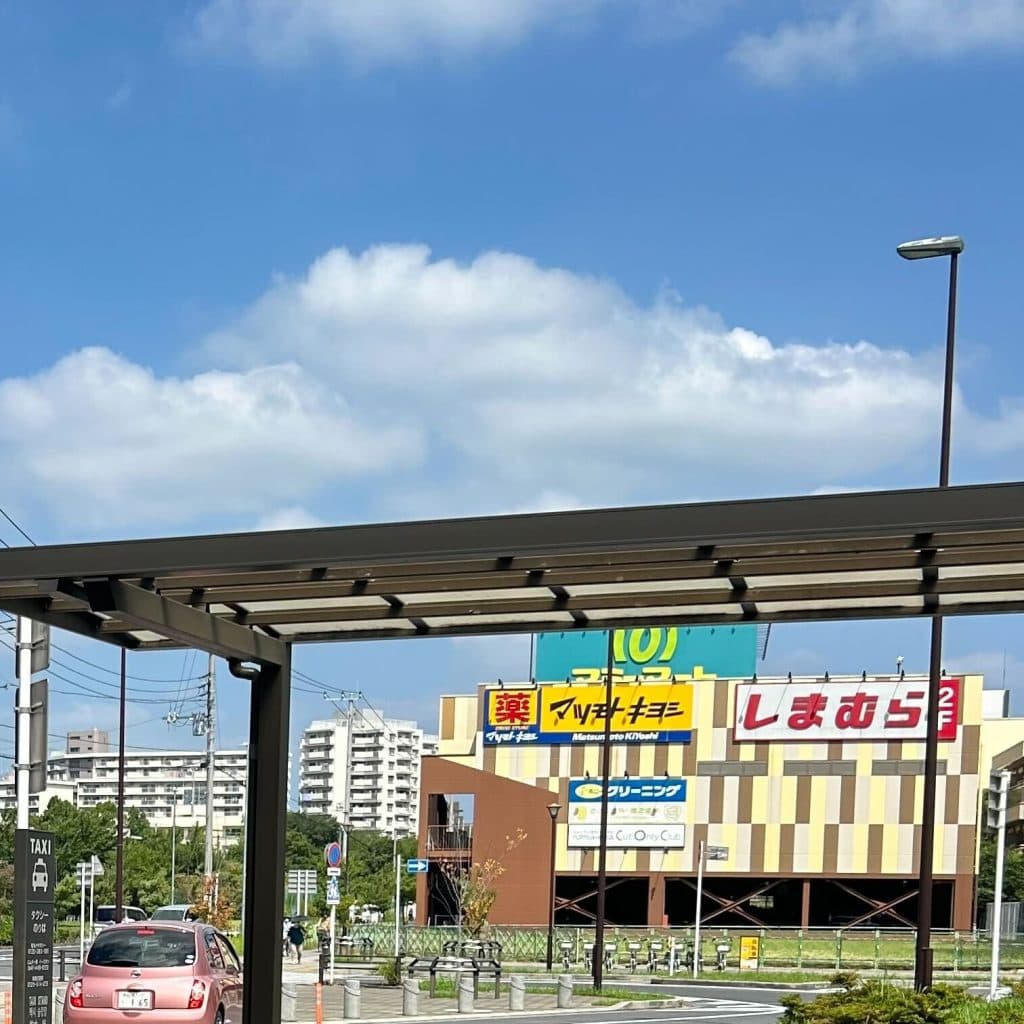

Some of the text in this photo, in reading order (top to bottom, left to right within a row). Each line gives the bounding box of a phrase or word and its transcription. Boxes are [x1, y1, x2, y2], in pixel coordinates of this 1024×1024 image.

[495, 692, 531, 724] 薬
[743, 691, 925, 731] しまむら
[608, 784, 682, 797] クリーニング
[634, 829, 659, 842] Only
[30, 838, 51, 855] TAXI
[31, 910, 49, 920] タクシー
